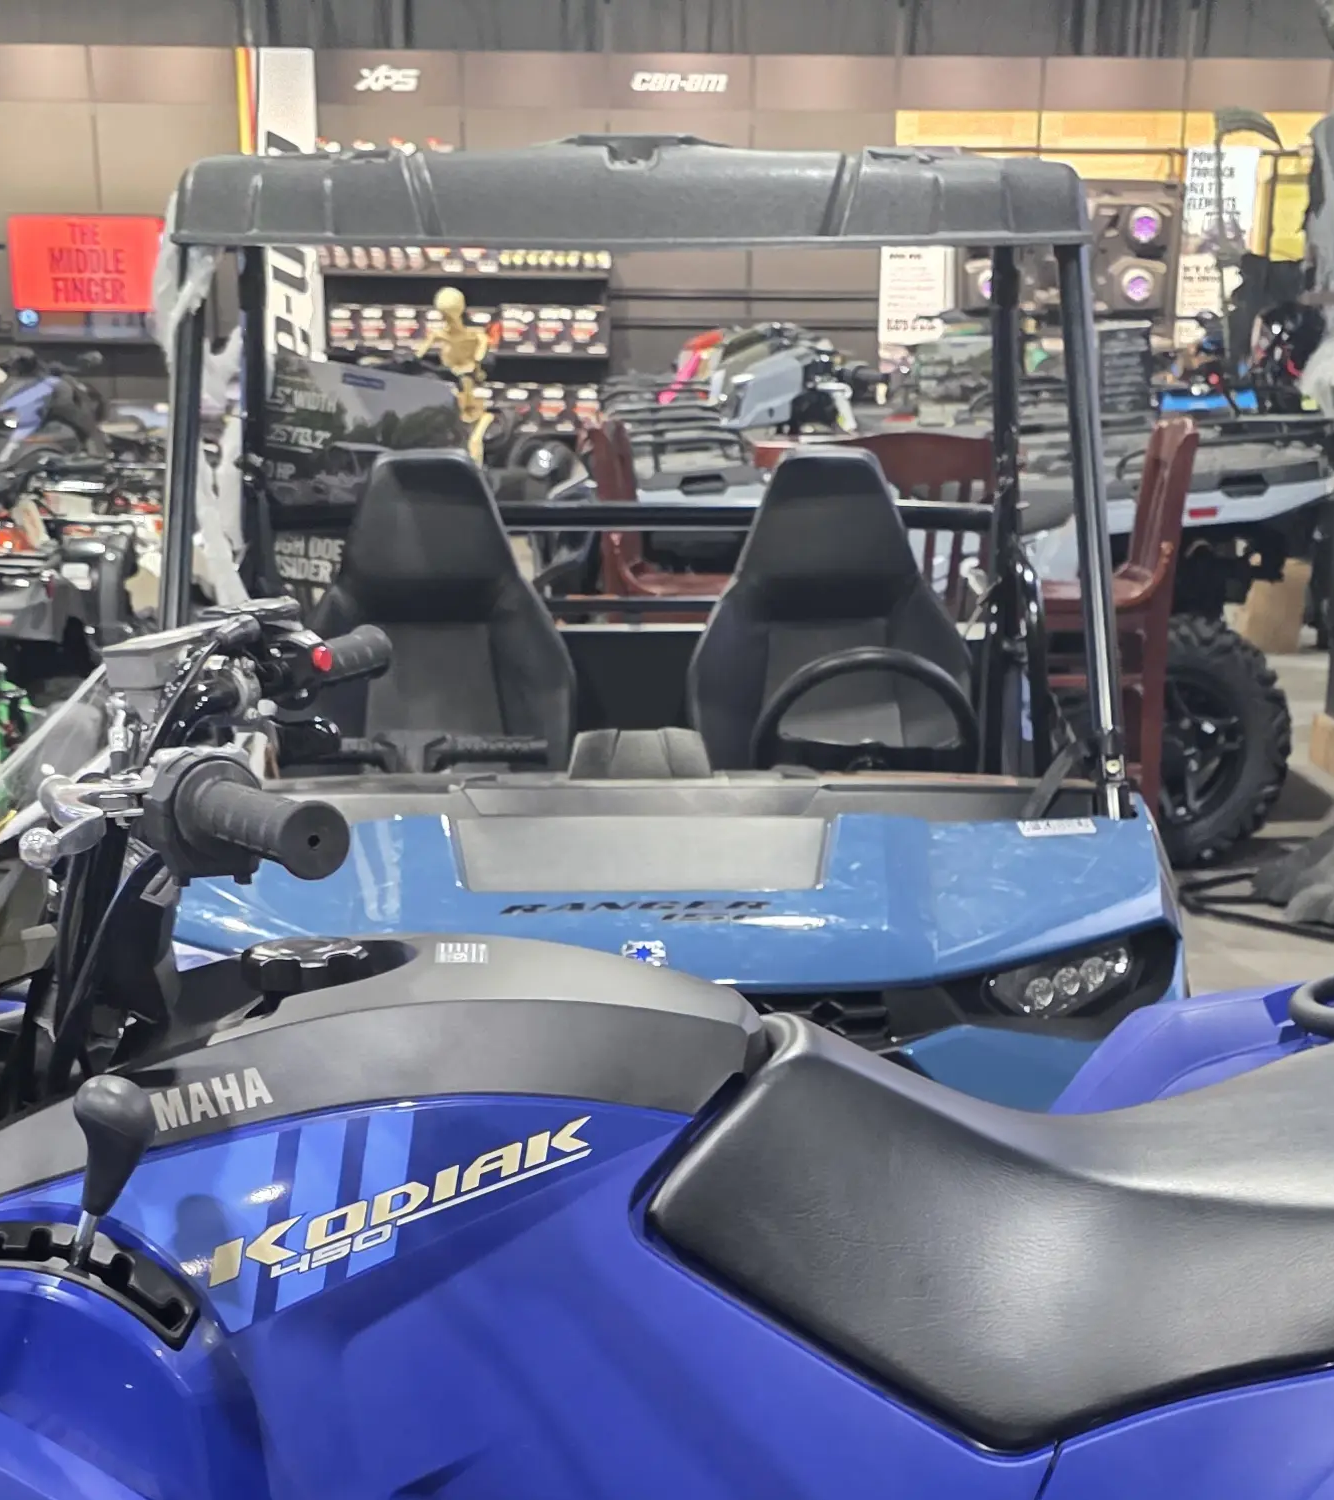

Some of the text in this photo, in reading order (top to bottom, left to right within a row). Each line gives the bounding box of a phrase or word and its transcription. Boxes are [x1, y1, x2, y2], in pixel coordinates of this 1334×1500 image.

[354, 64, 421, 92] XPS
[67, 223, 100, 245] THE
[48, 247, 126, 274] MIDDLE
[52, 277, 126, 304] FINGER
[499, 900, 771, 915] RANGER
[149, 1067, 273, 1132] MAHA
[208, 1115, 592, 1288] KODIAK
[270, 1222, 392, 1280] 450
